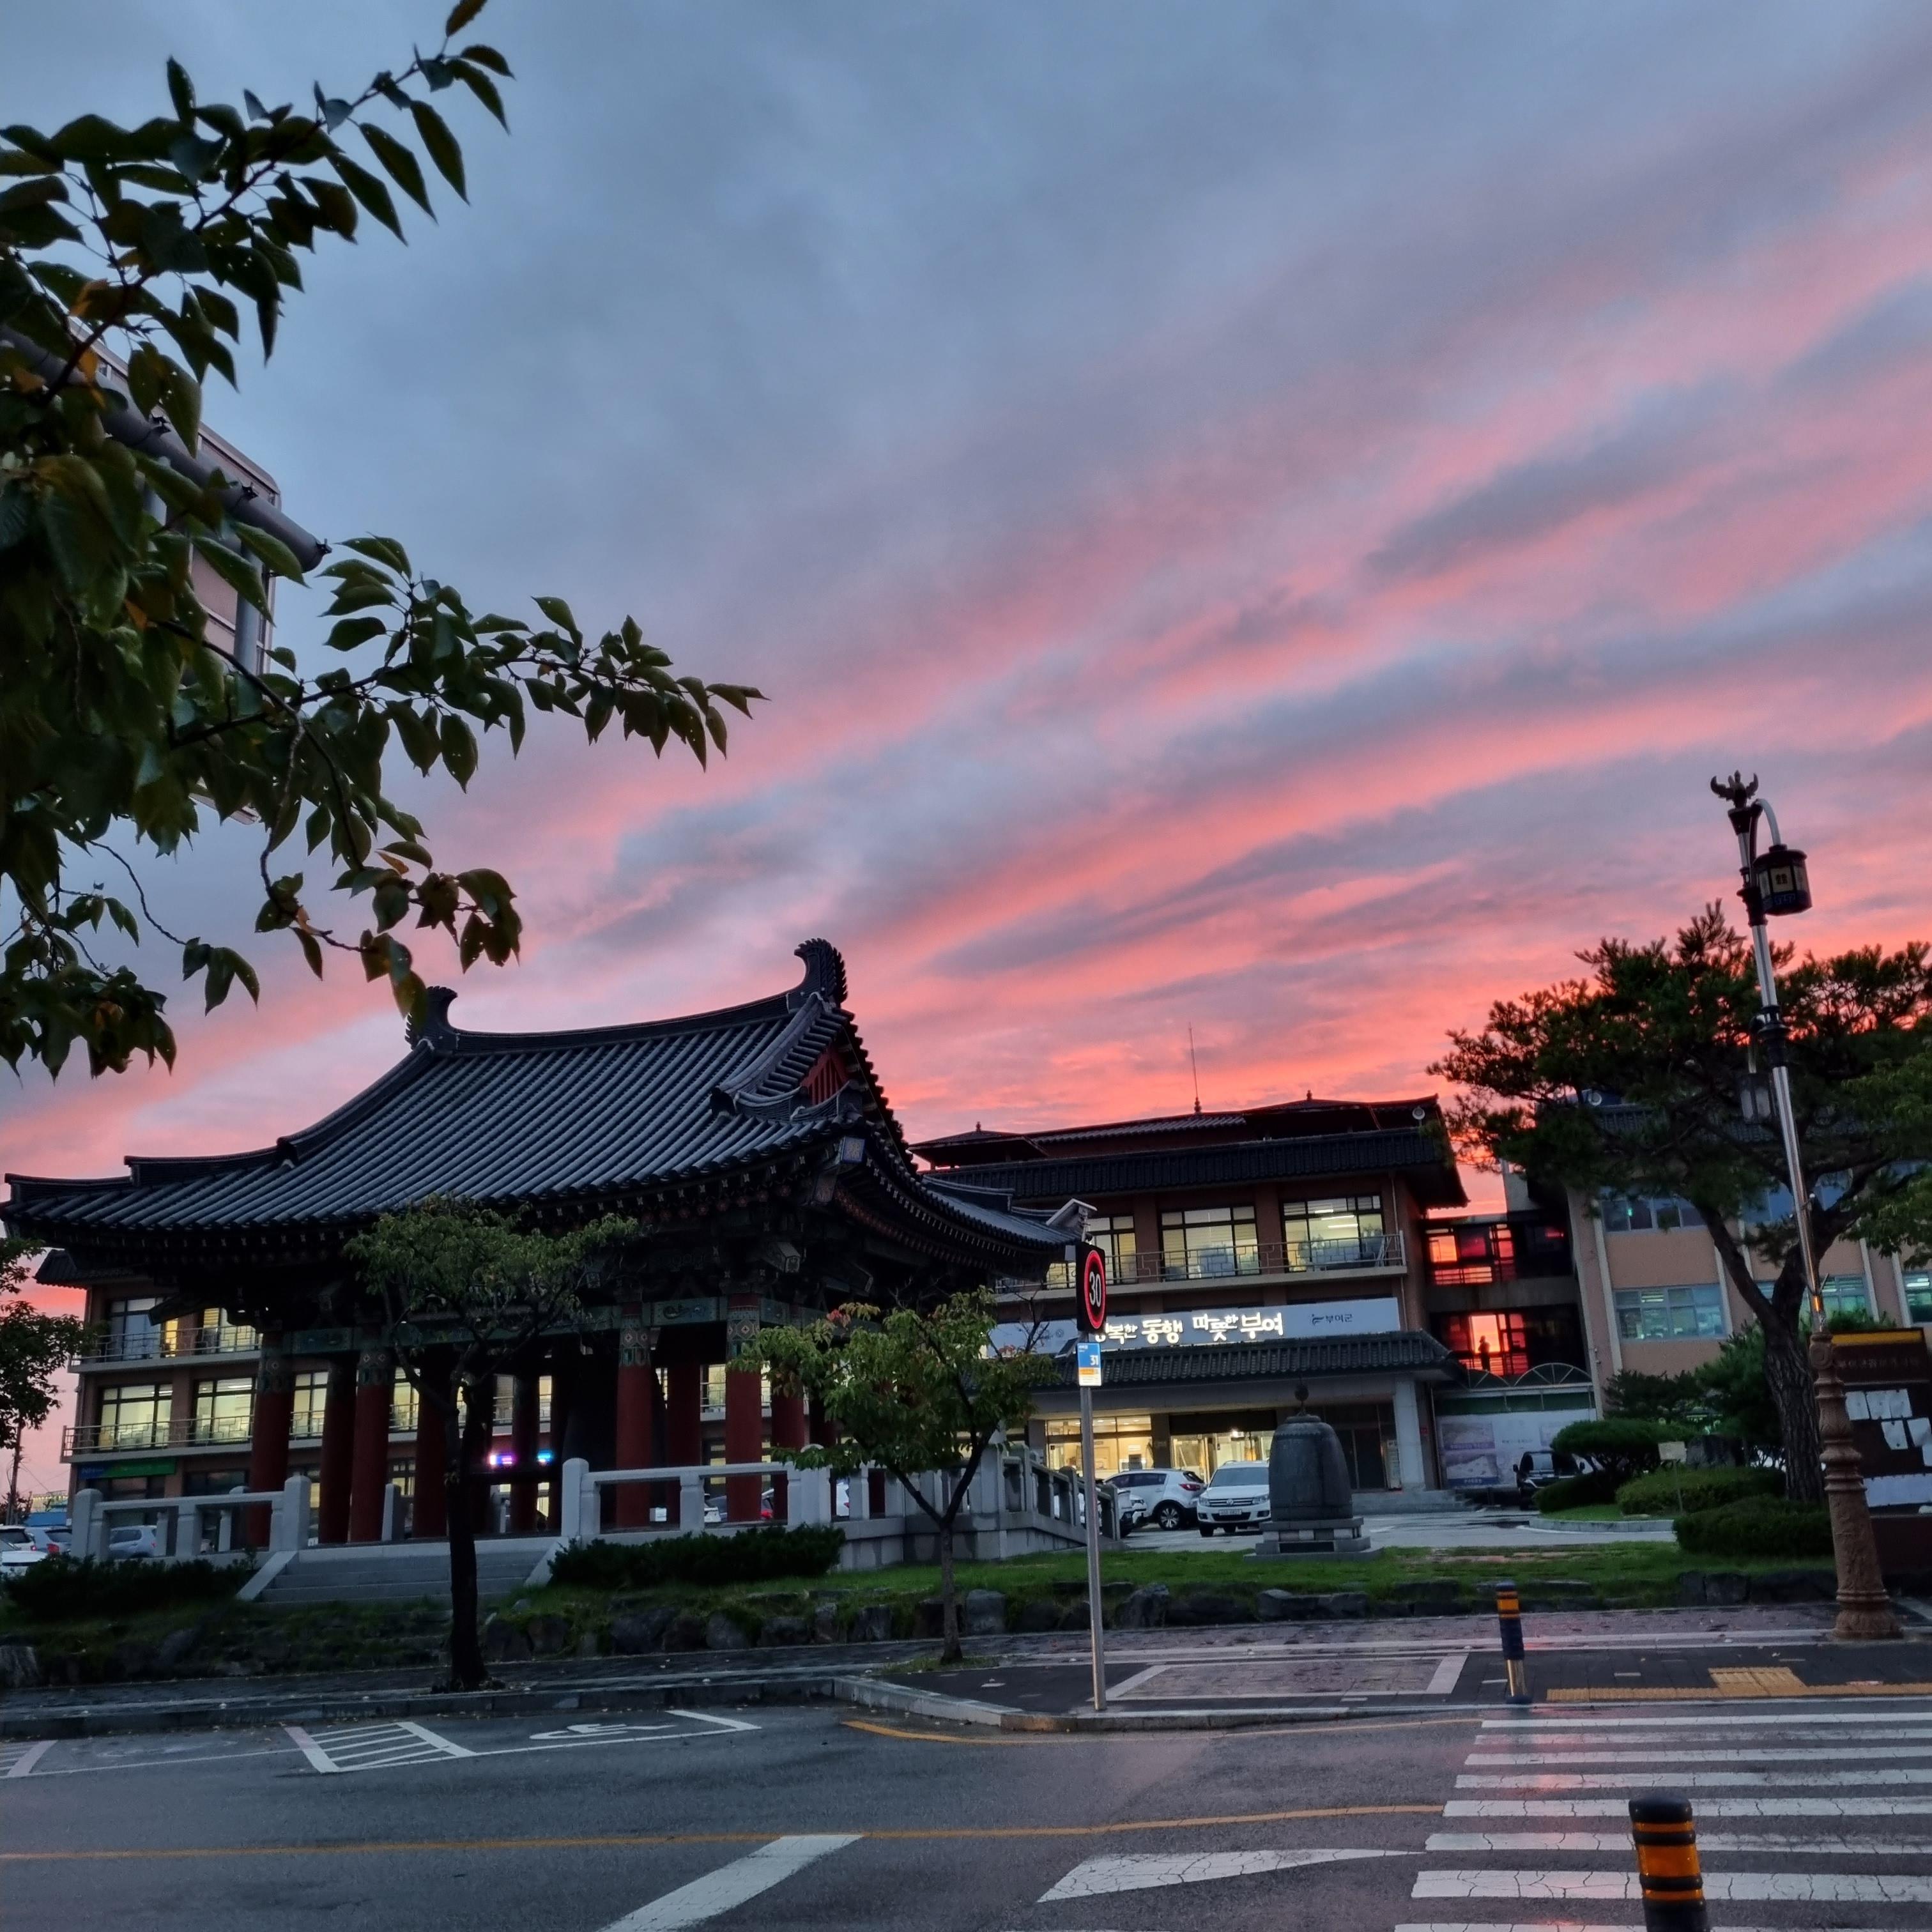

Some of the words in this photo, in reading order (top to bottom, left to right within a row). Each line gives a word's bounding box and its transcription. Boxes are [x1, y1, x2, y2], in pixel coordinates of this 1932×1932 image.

[1089, 1271, 1101, 1308] 30
[1142, 1318, 1183, 1344] 동행
[1192, 1314, 1238, 1341] 따뜻한
[1240, 1312, 1284, 1339] 부여
[1089, 1354, 1099, 1365] 31
